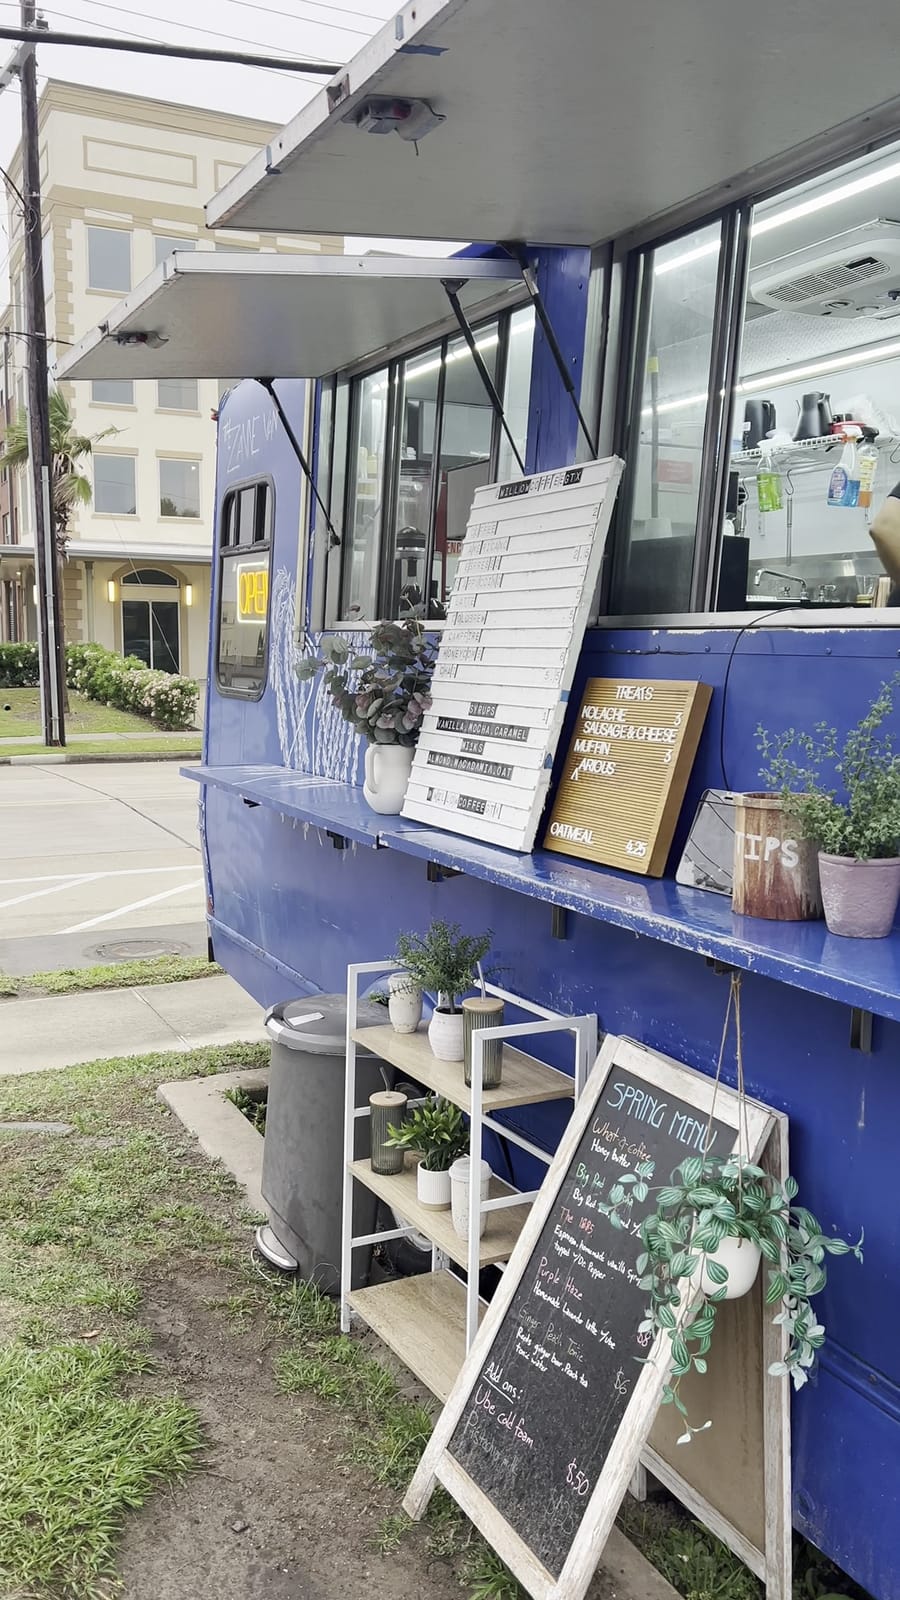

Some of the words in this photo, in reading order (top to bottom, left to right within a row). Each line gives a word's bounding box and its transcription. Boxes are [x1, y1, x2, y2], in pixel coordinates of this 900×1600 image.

[616, 685, 654, 701] TREATS
[469, 703, 497, 717] SYRUPS
[581, 705, 628, 722] KOLACHE
[674, 712, 683, 726] 3
[573, 739, 610, 755] MUFFIN
[664, 749, 673, 763] 3
[550, 822, 594, 844] OATMEAL
[735, 831, 800, 868] TIPS
[607, 1083, 668, 1129] SPRING
[668, 1111, 718, 1154] MENU
[590, 1138, 611, 1162] Honey
[611, 1148, 632, 1168] butter
[576, 1162, 590, 1187] Big
[593, 1172, 606, 1188] Red
[573, 1187, 584, 1206] Big
[561, 1206, 574, 1224] The
[554, 1240, 570, 1257] topped
[587, 1261, 606, 1280] Pepper
[537, 1256, 560, 1284] Purple
[565, 1276, 584, 1301] Haze
[533, 1280, 561, 1309] Homemade
[519, 1303, 542, 1333] Ginger
[567, 1337, 584, 1363] Tonic
[484, 1362, 503, 1383] Add
[515, 1342, 530, 1360] tonic
[531, 1357, 548, 1372] water
[614, 1367, 631, 1395] $6
[533, 1343, 551, 1360] ginger
[564, 1362, 578, 1381] Peach
[475, 1384, 496, 1415] Ube
[497, 1411, 517, 1430] cold
[514, 1418, 534, 1448] foam
